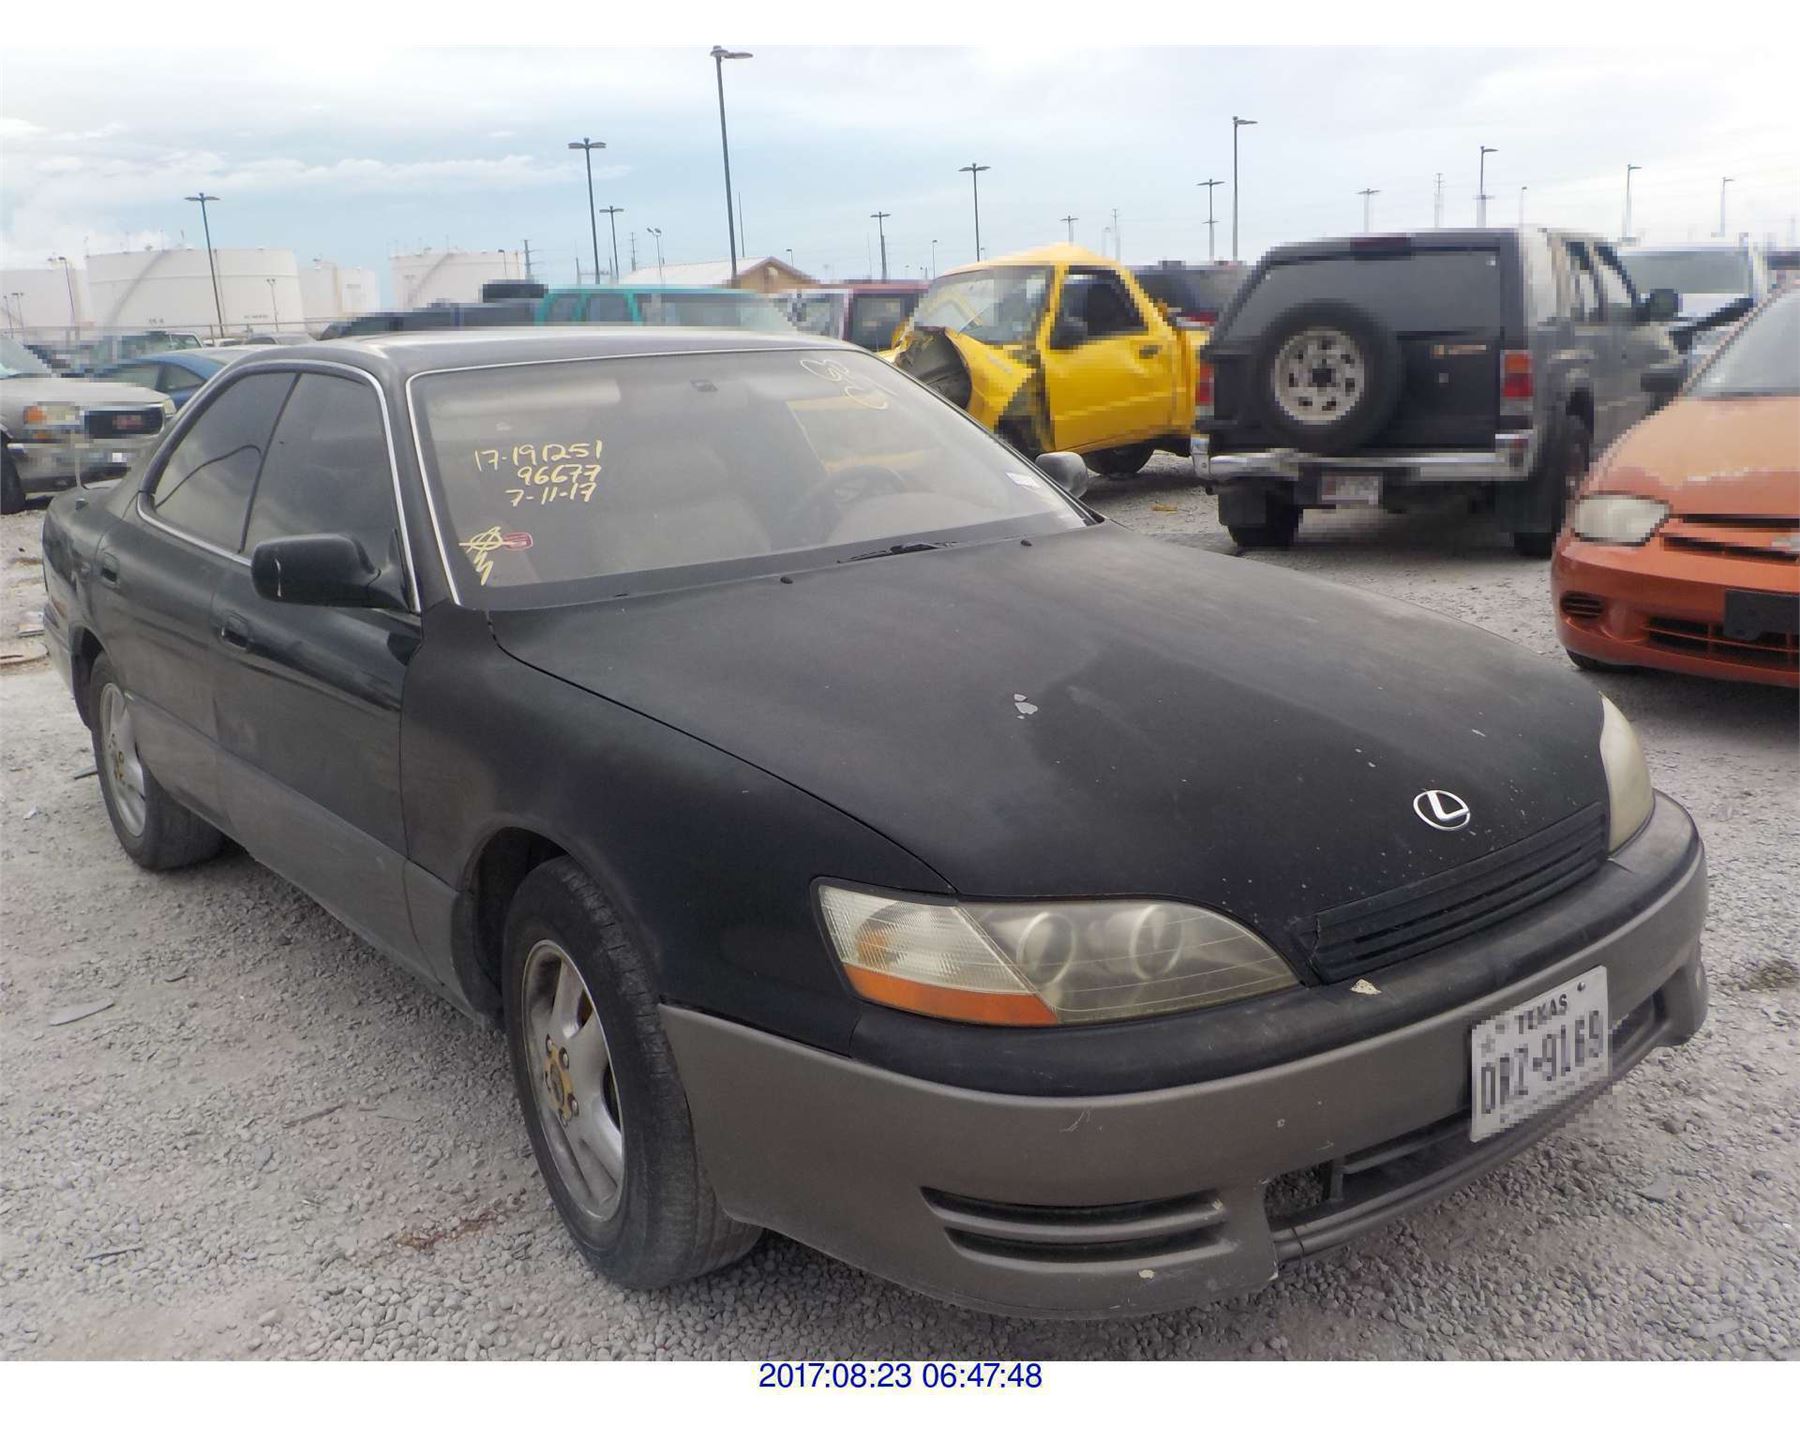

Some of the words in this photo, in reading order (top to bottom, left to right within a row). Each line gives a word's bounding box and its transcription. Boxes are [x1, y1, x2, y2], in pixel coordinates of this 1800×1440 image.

[474, 439, 603, 472] 17-191251
[517, 464, 601, 486] 96677
[504, 482, 597, 507] 7-11-17
